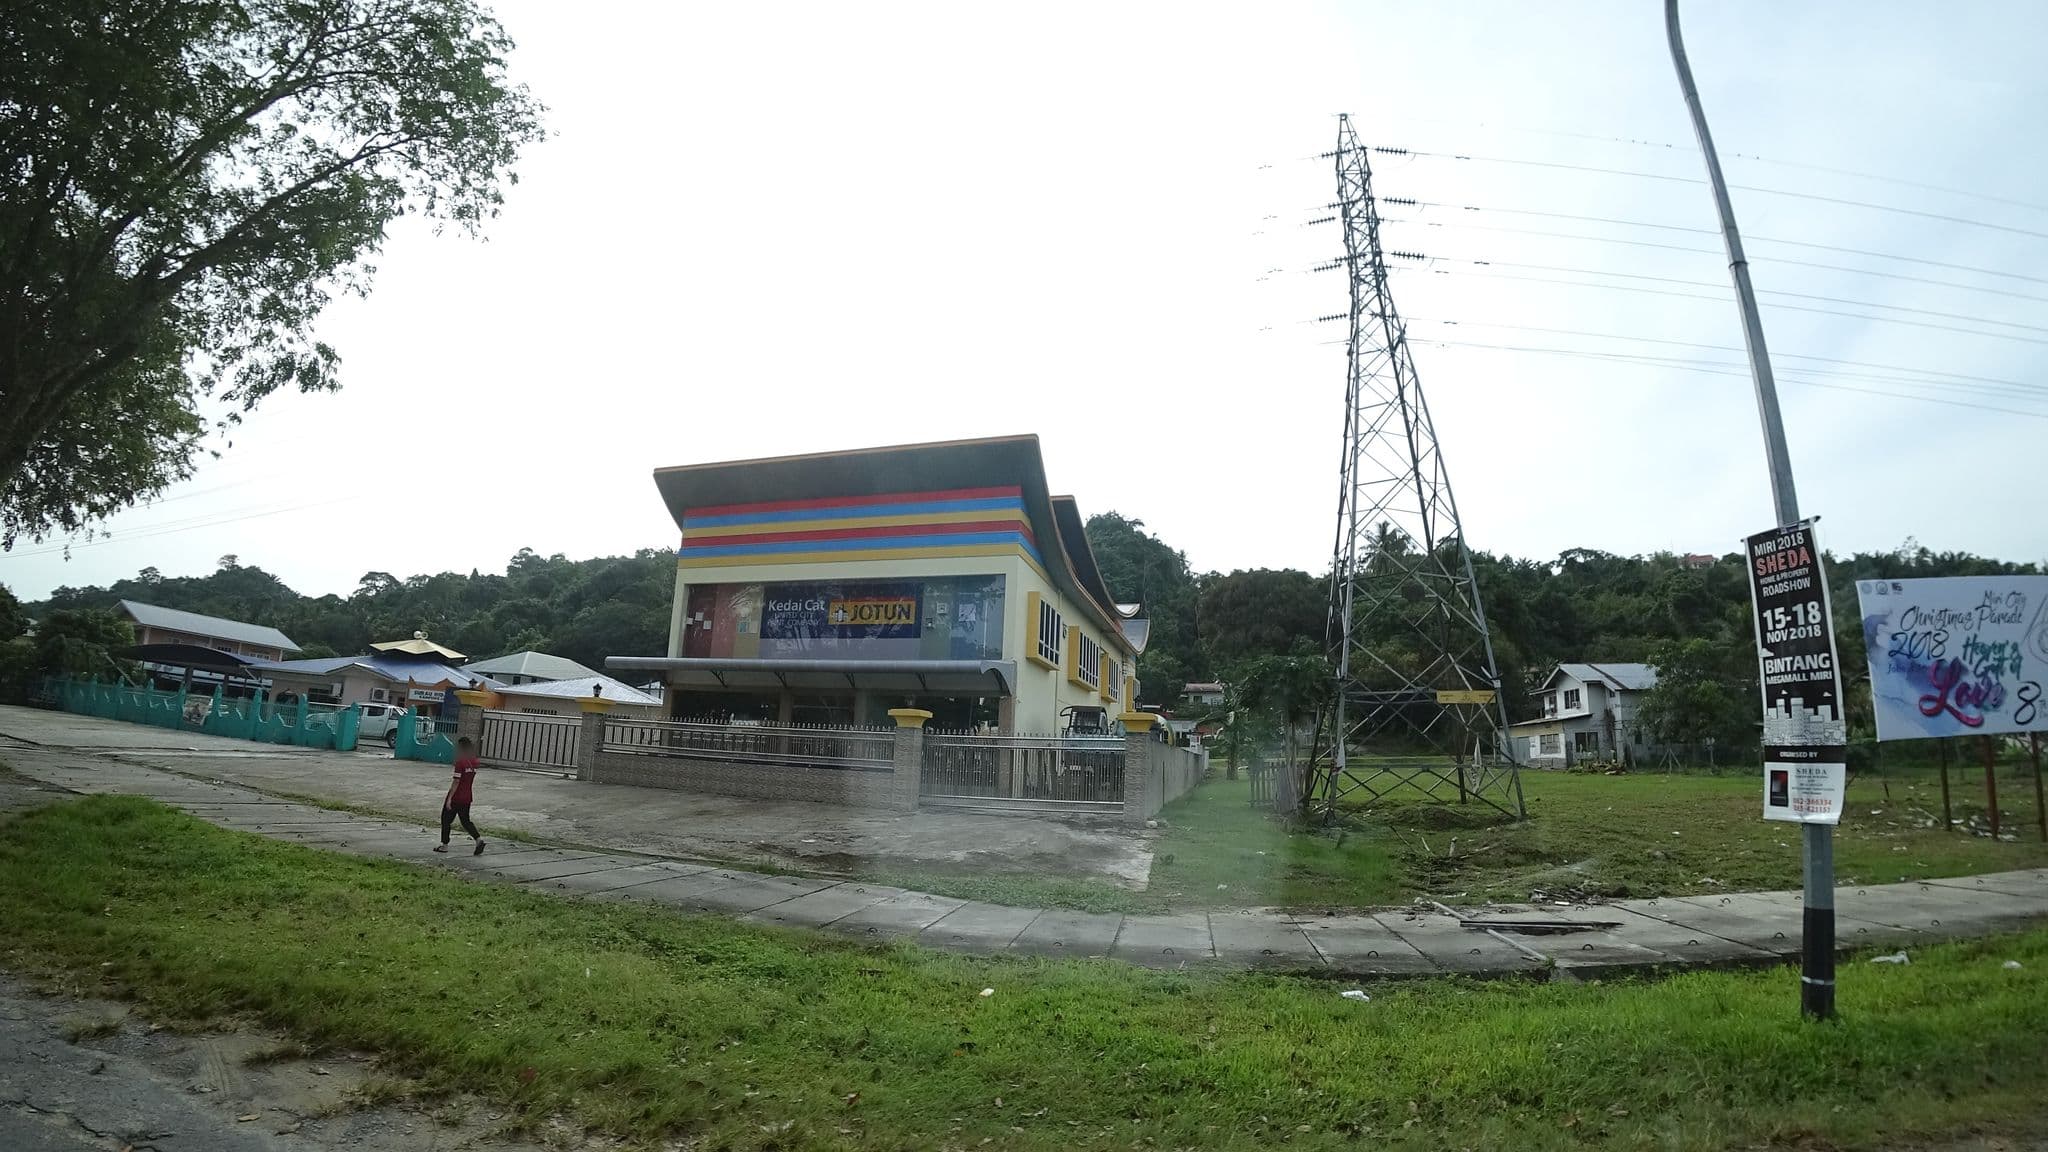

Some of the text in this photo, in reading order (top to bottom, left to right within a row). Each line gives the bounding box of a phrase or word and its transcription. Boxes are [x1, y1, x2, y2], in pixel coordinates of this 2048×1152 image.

[1754, 532, 1805, 557] MIRI 2018
[1756, 546, 1811, 576] SHEDA
[1762, 577, 1811, 597] ROADSHOW
[768, 599, 825, 612] Kedai Cat
[850, 603, 911, 621] JOTUN
[1762, 600, 1822, 631] 15-18
[1901, 606, 2022, 631] Christmas Parade
[1766, 624, 1822, 644] NOV 2018
[1889, 630, 1949, 660] 2018
[1765, 653, 1831, 675] BINTANG
[1766, 670, 1833, 685] MEGAMALL MIRI
[2015, 681, 2042, 725] 8
